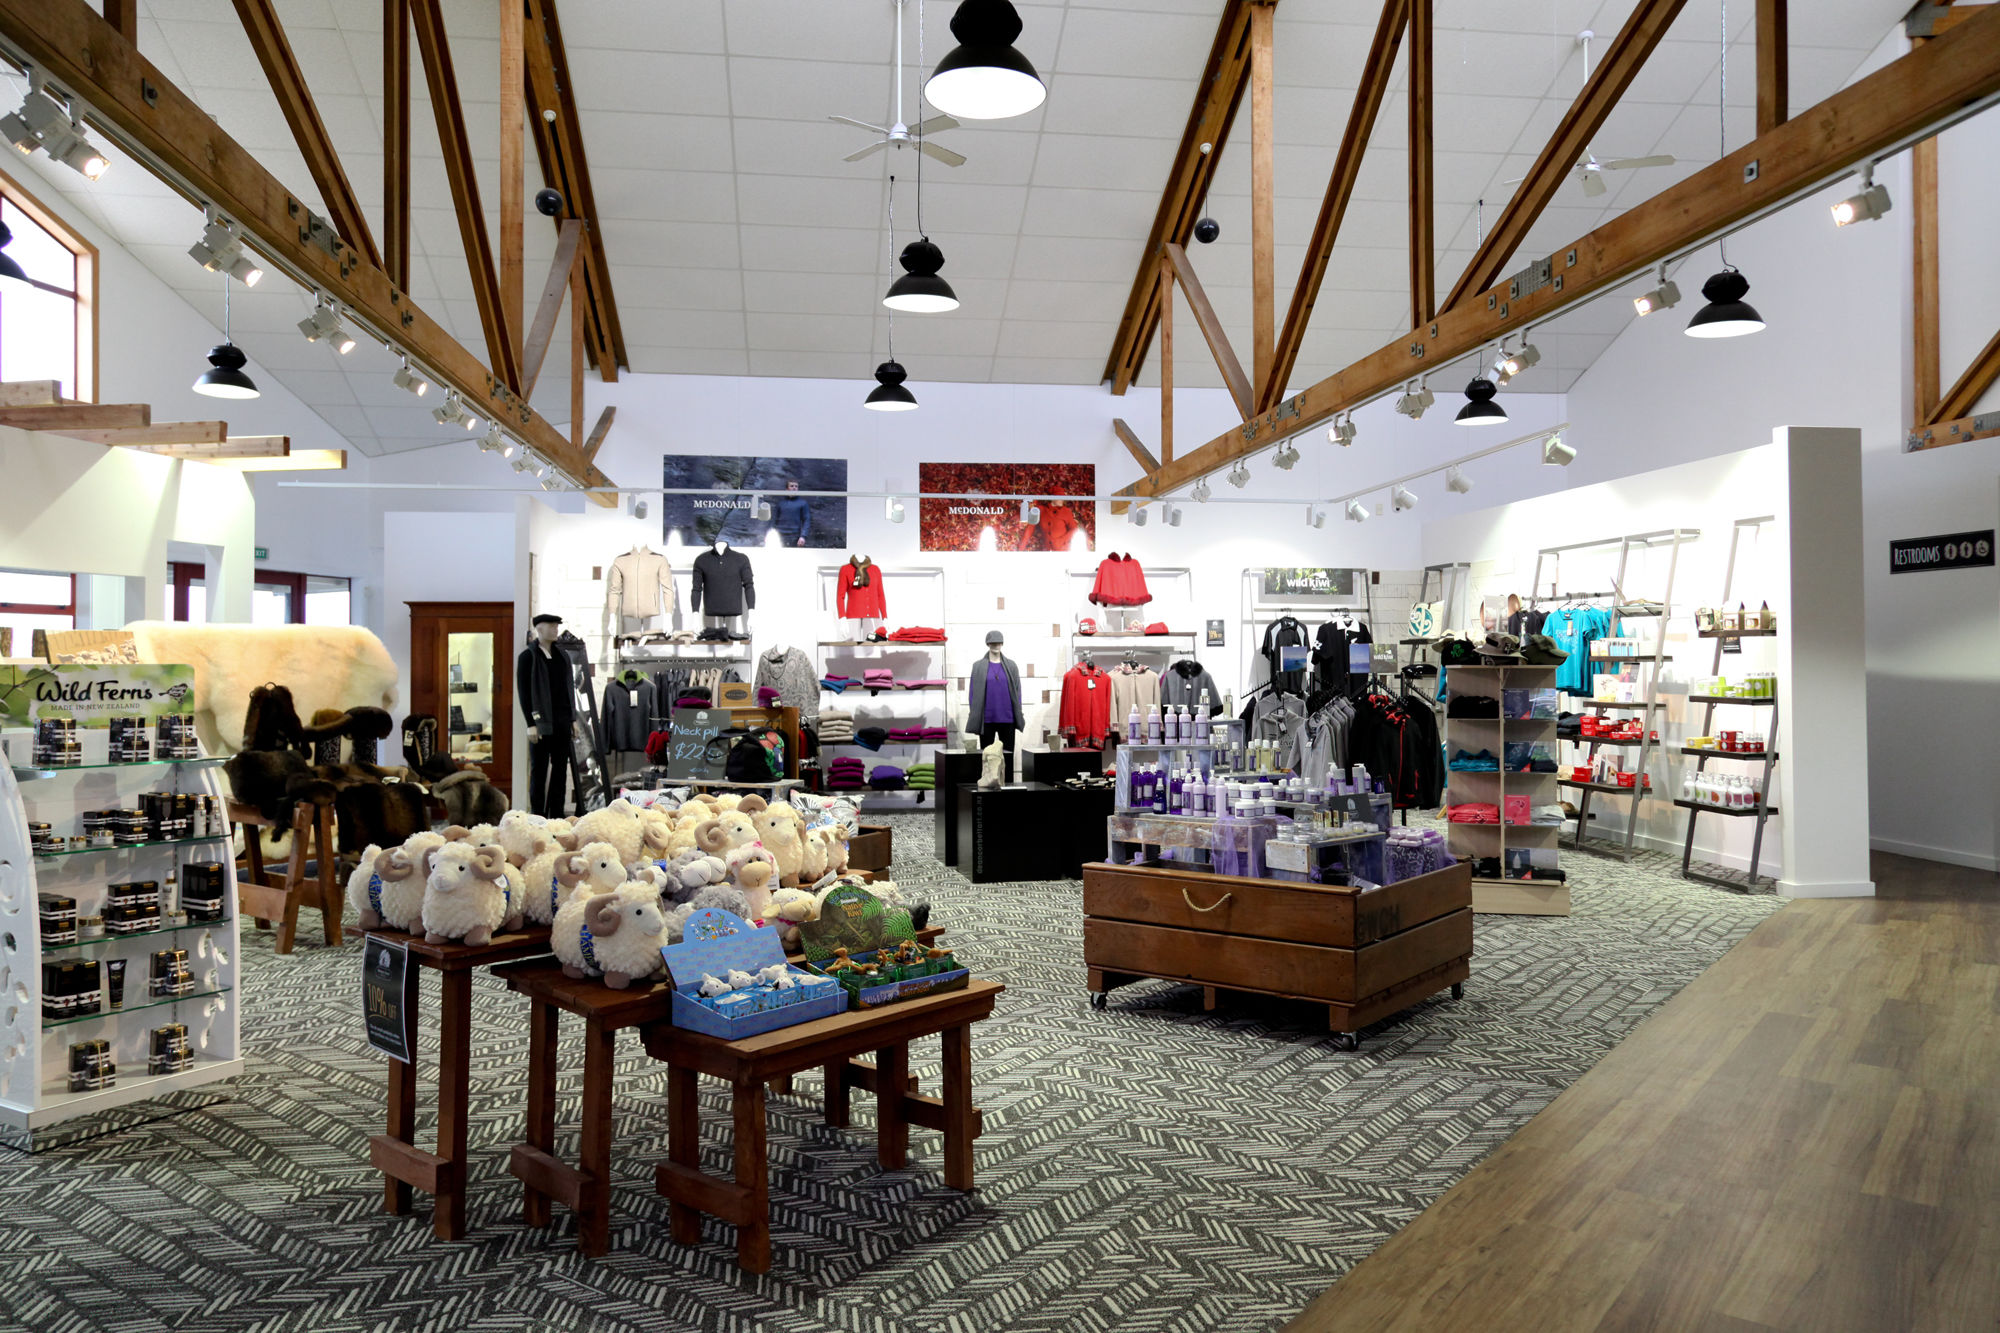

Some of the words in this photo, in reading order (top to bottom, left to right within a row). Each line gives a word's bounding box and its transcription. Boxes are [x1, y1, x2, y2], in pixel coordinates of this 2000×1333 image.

[1895, 545, 1941, 566] RESTROOMS
[1287, 577, 1308, 588] wild
[1309, 577, 1330, 589] kiwi
[36, 680, 93, 702] Wild
[96, 680, 153, 701] Ferns
[87, 703, 104, 711] NEW
[106, 702, 141, 710] ZEALAND
[674, 724, 701, 736] Neck
[702, 725, 719, 741] pill
[367, 983, 388, 1016] 10%
